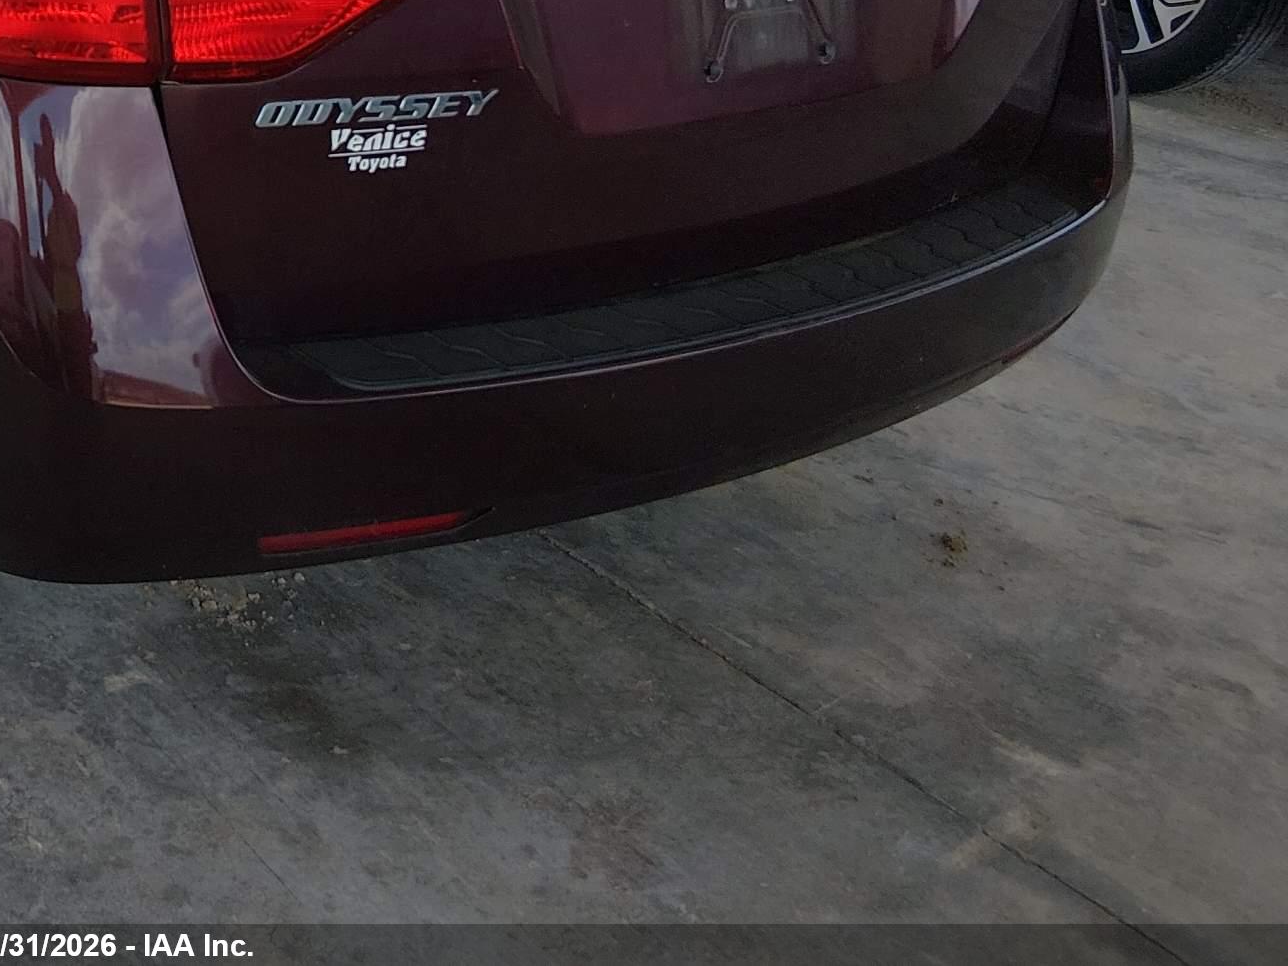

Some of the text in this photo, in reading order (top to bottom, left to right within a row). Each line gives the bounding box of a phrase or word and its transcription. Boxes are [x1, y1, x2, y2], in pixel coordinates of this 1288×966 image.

[255, 89, 499, 128] ODYSSEY
[330, 124, 428, 152] Venice
[348, 155, 407, 173] Toyota
